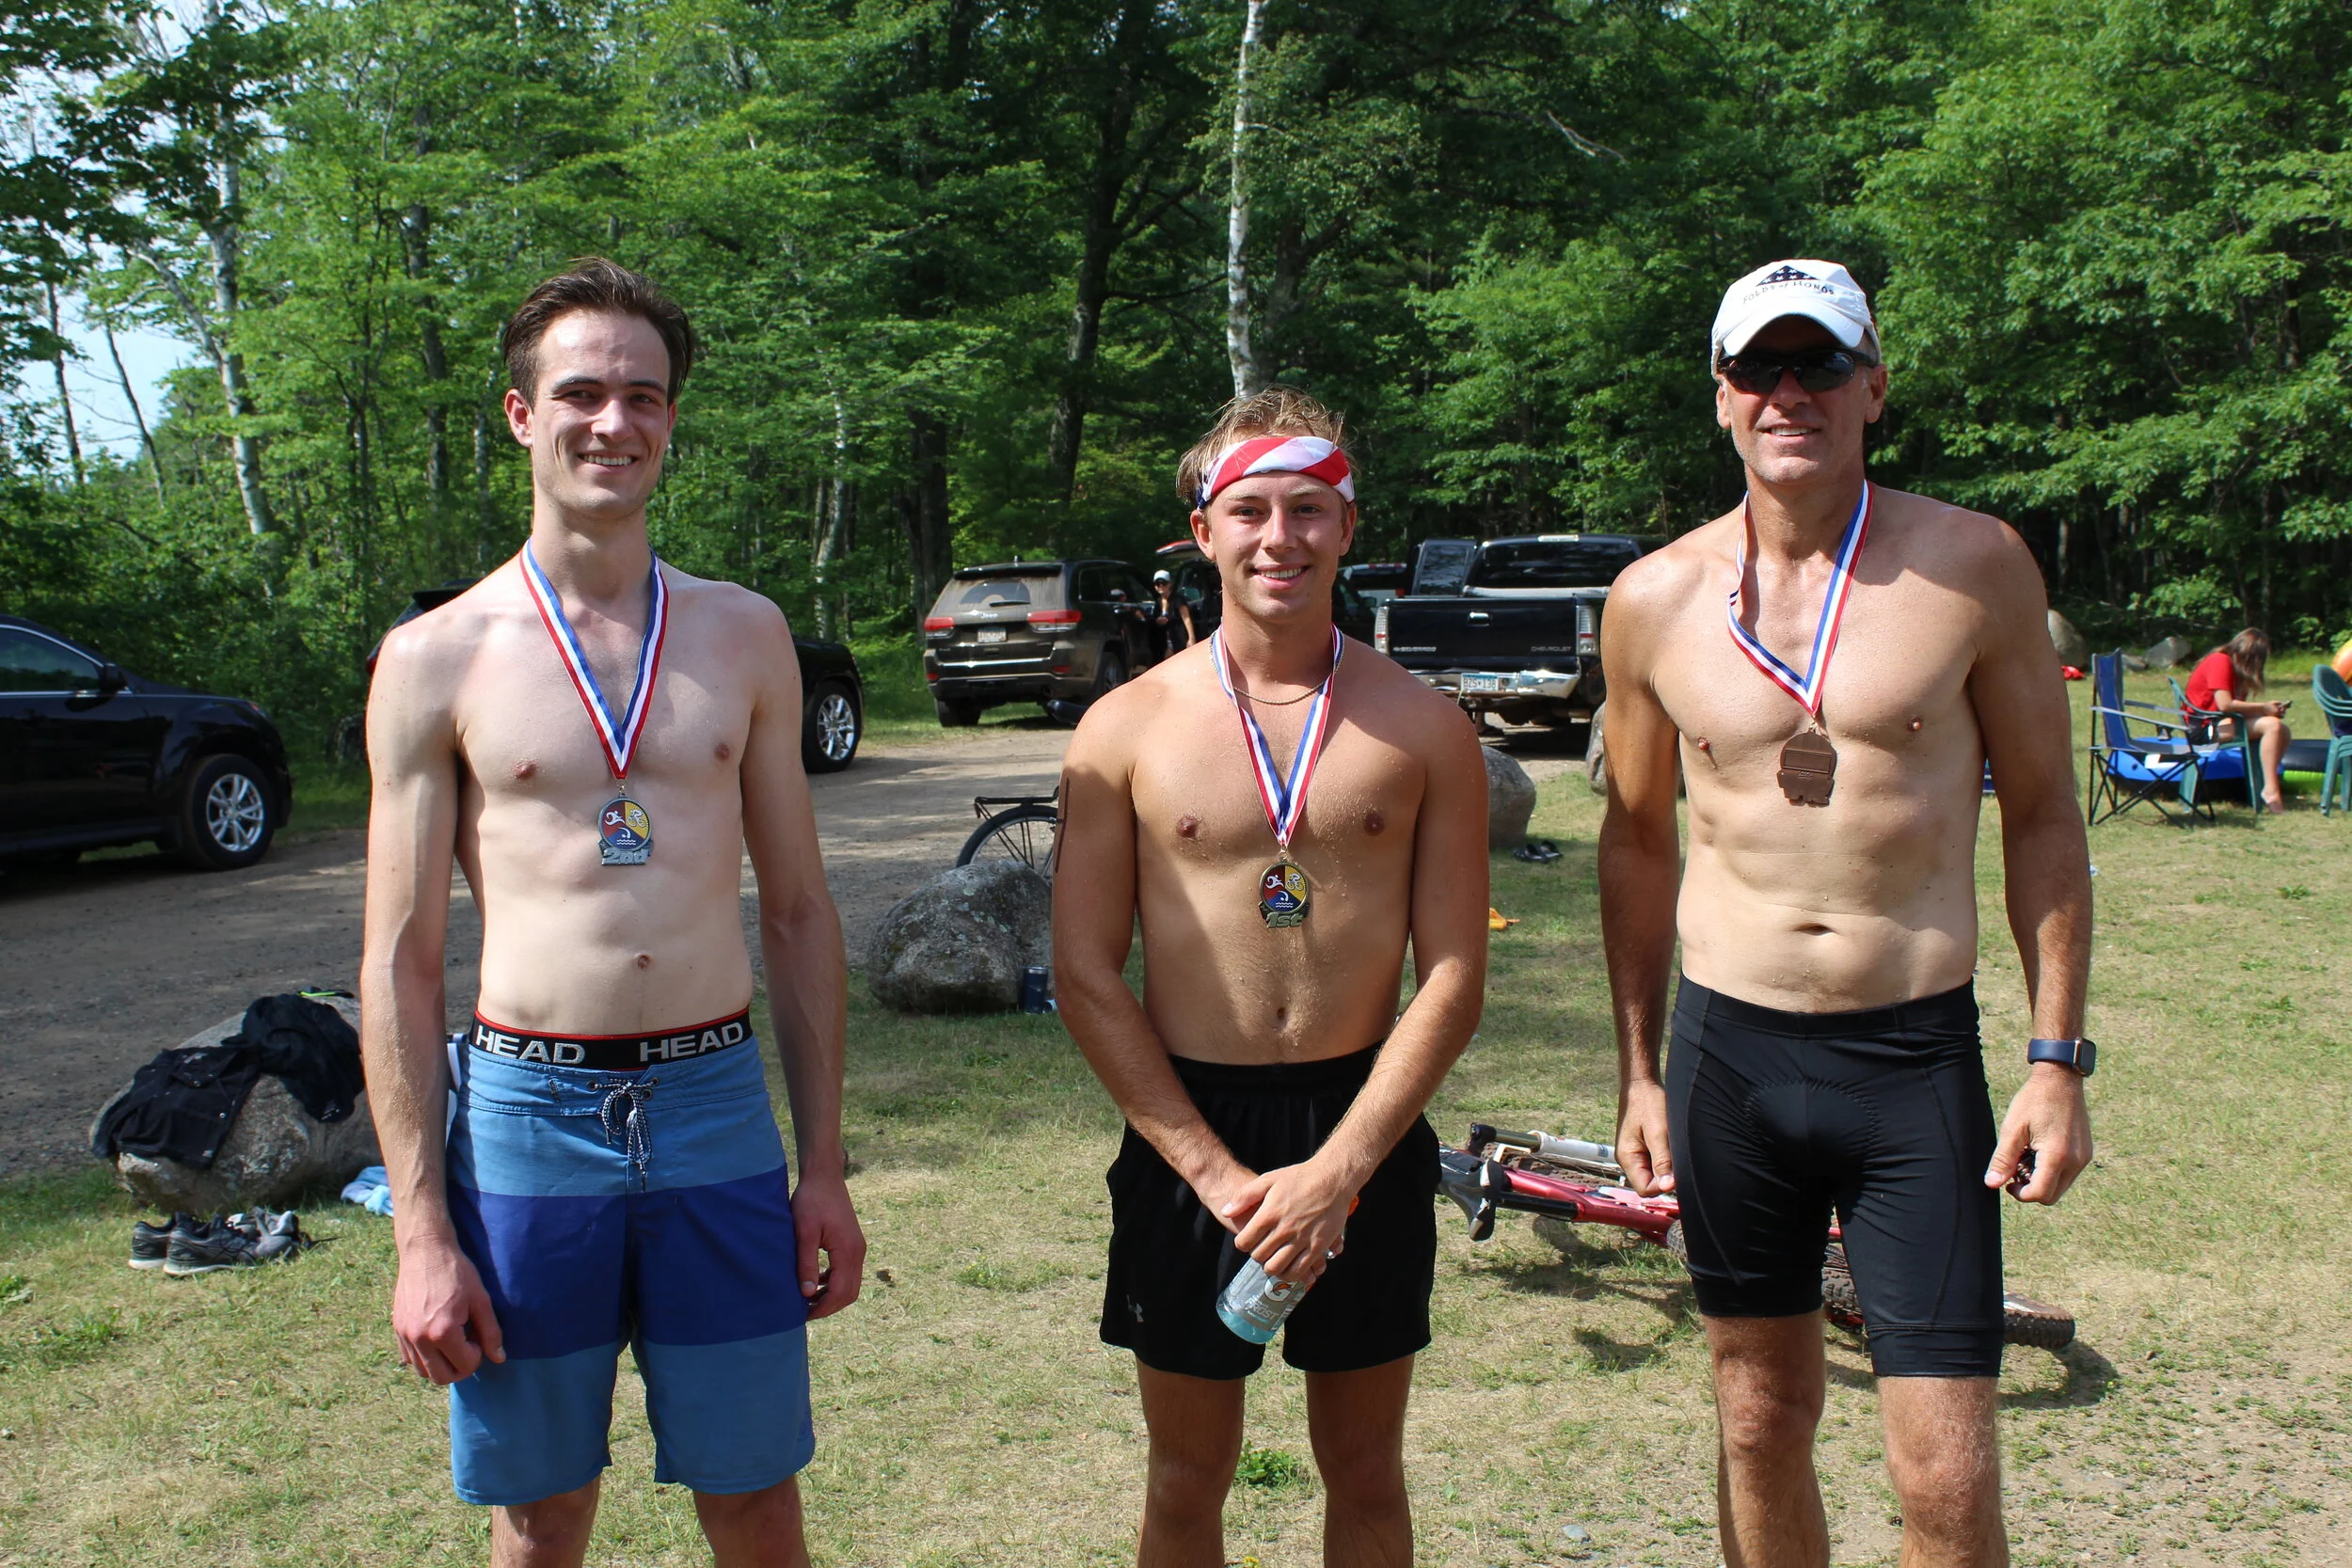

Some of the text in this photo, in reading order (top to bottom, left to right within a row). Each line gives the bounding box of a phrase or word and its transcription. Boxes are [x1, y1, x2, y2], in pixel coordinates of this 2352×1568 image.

[1742, 285, 1775, 304] FOLDS
[601, 847, 649, 865] 2nd
[1265, 911, 1304, 928] 1st
[475, 1021, 743, 1065] HEAD HEAD
[1243, 1297, 1279, 1320] FROST
